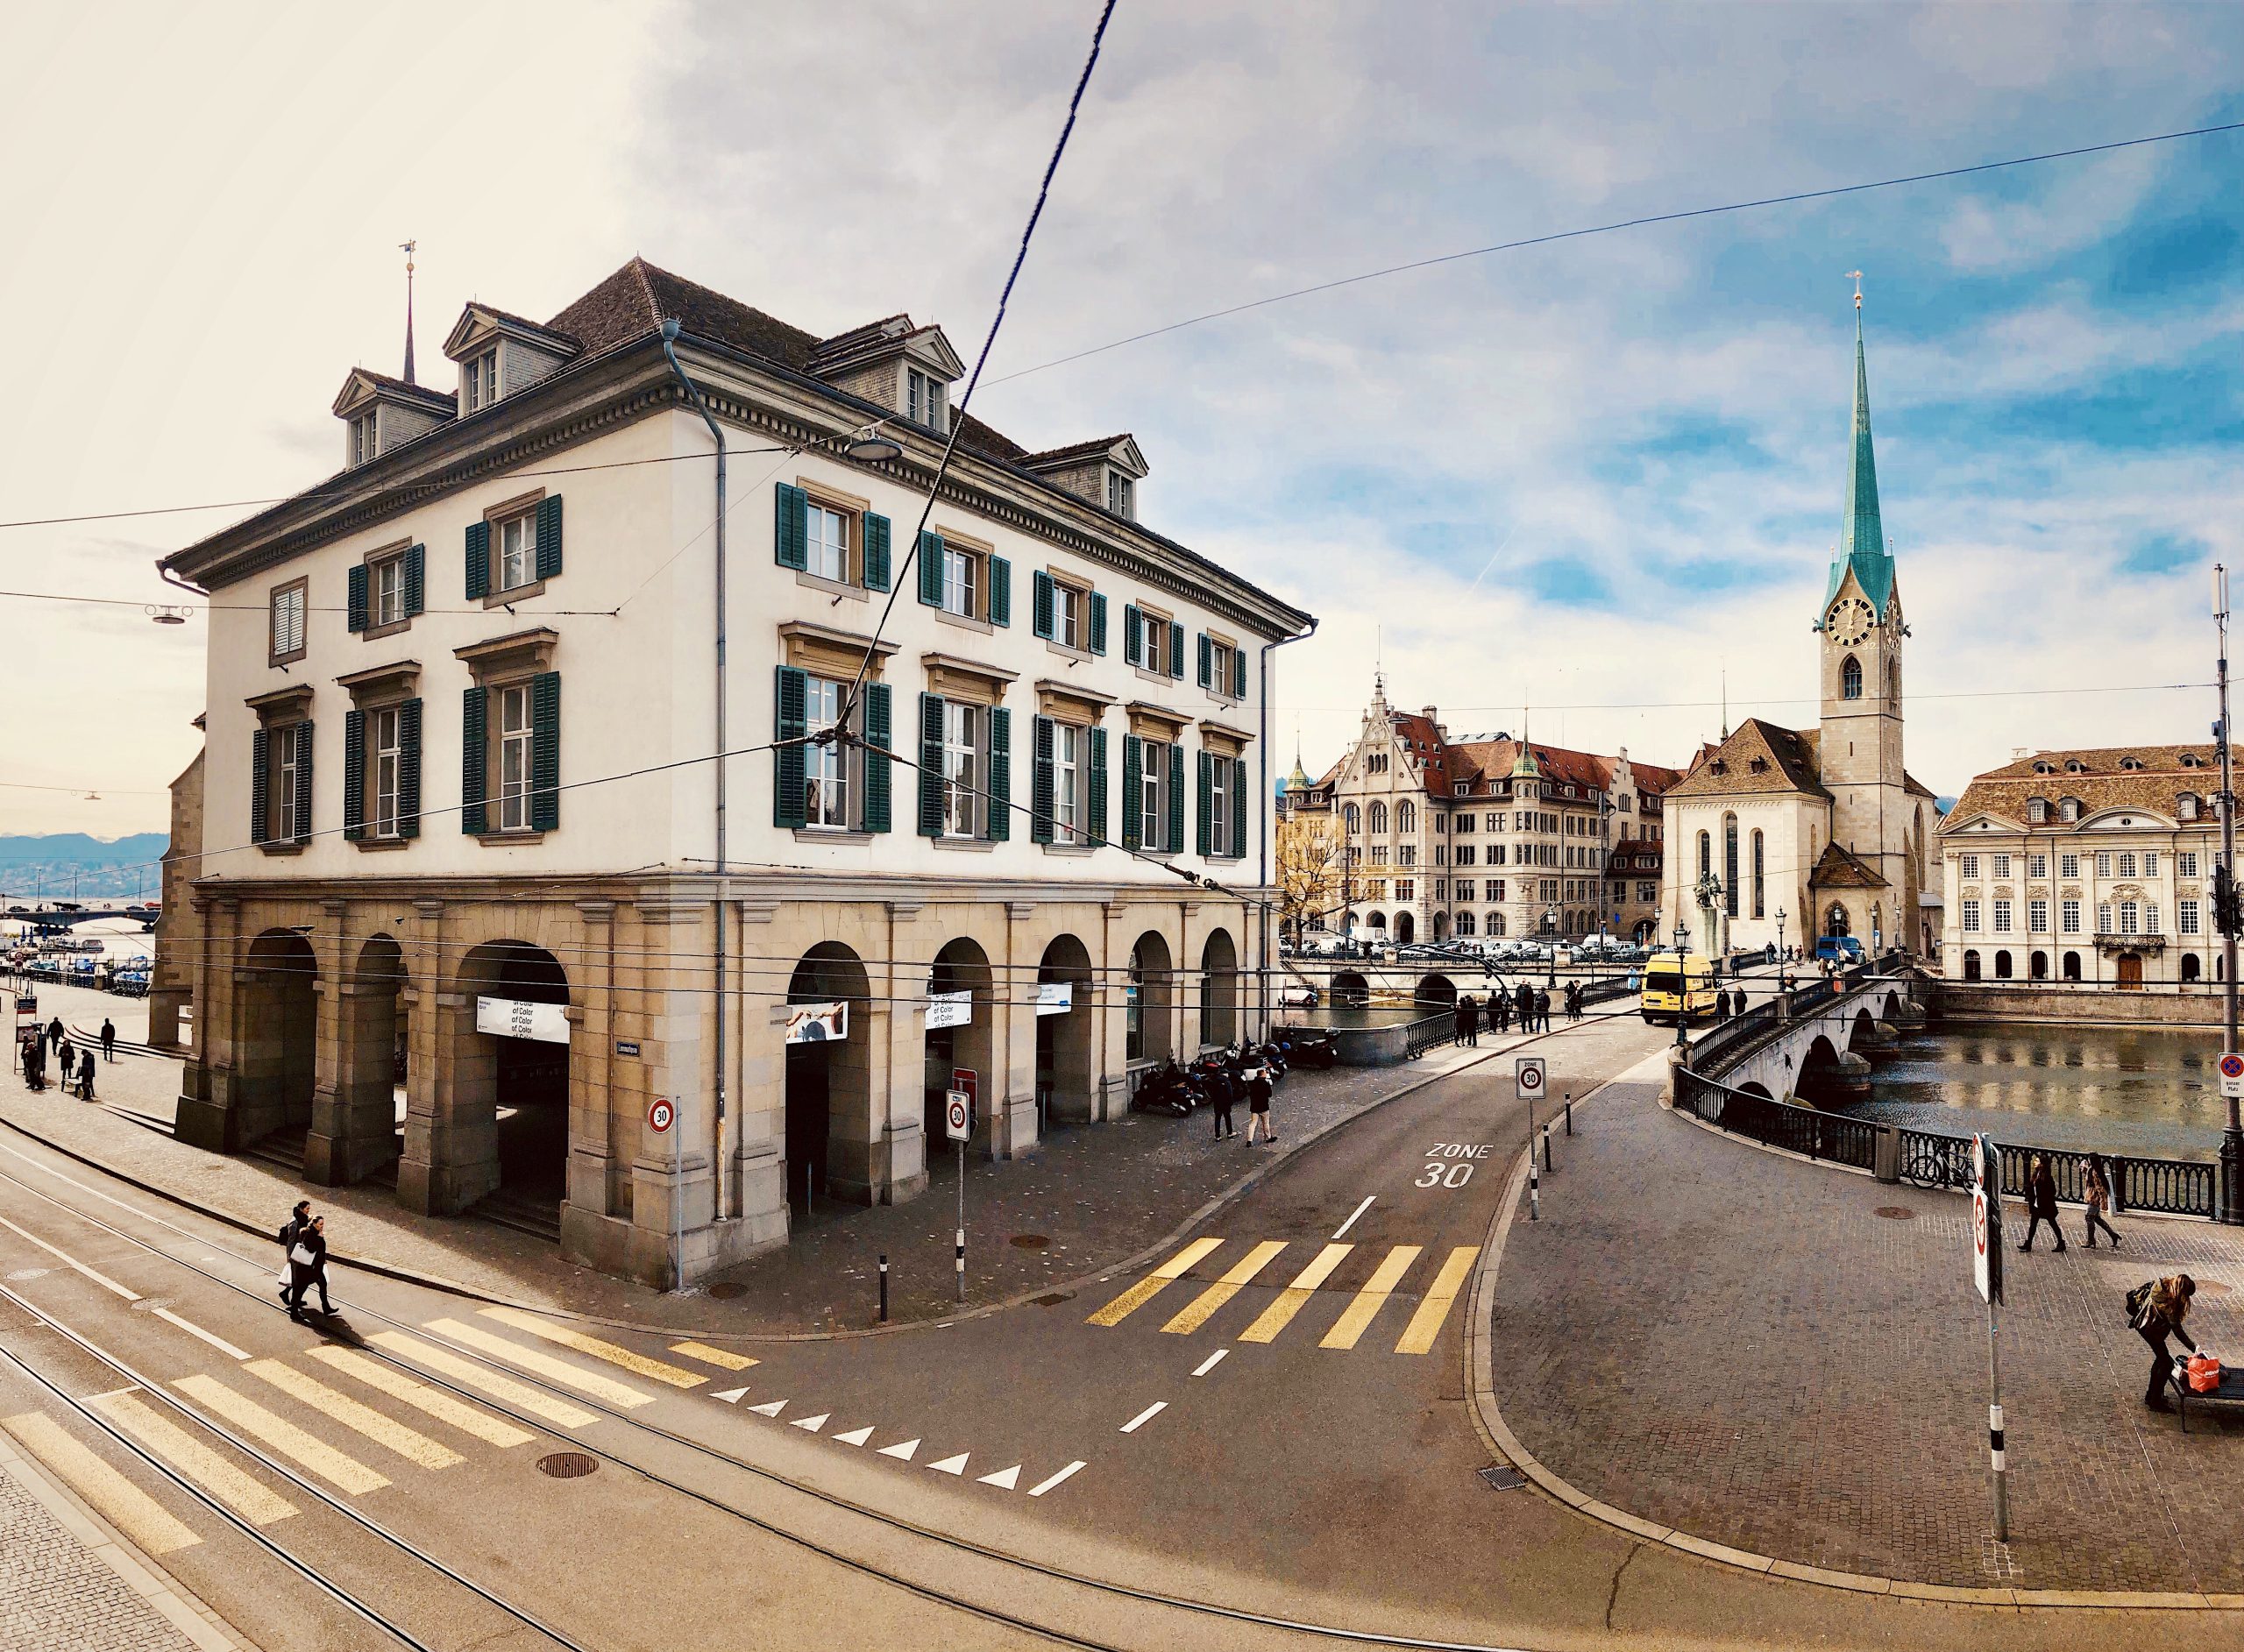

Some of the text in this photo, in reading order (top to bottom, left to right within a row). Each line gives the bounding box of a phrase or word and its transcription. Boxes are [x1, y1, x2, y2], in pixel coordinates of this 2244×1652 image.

[519, 1007, 533, 1016] Color
[518, 1016, 533, 1025] Color
[518, 1025, 532, 1033] Color
[1526, 1074, 1536, 1083] 30
[657, 1110, 667, 1123] 30
[953, 1110, 962, 1122] 30
[1424, 1143, 1495, 1159] ZONE
[1414, 1162, 1474, 1188] 30
